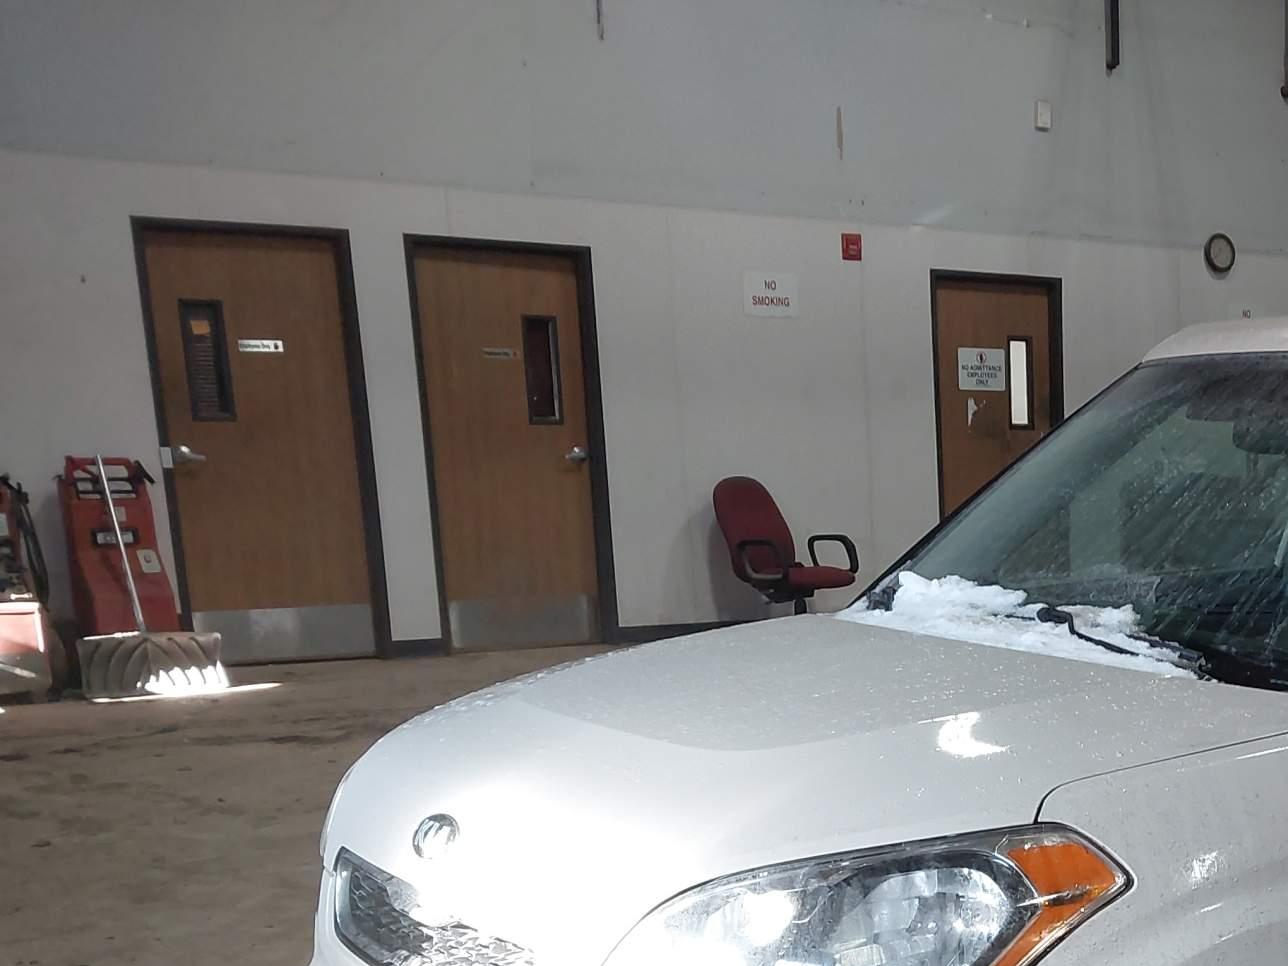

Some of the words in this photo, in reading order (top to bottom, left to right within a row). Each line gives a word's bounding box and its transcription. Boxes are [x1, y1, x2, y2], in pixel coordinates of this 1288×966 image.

[764, 280, 777, 290] NO
[752, 295, 790, 307] SMOKING
[1242, 309, 1251, 319] NO
